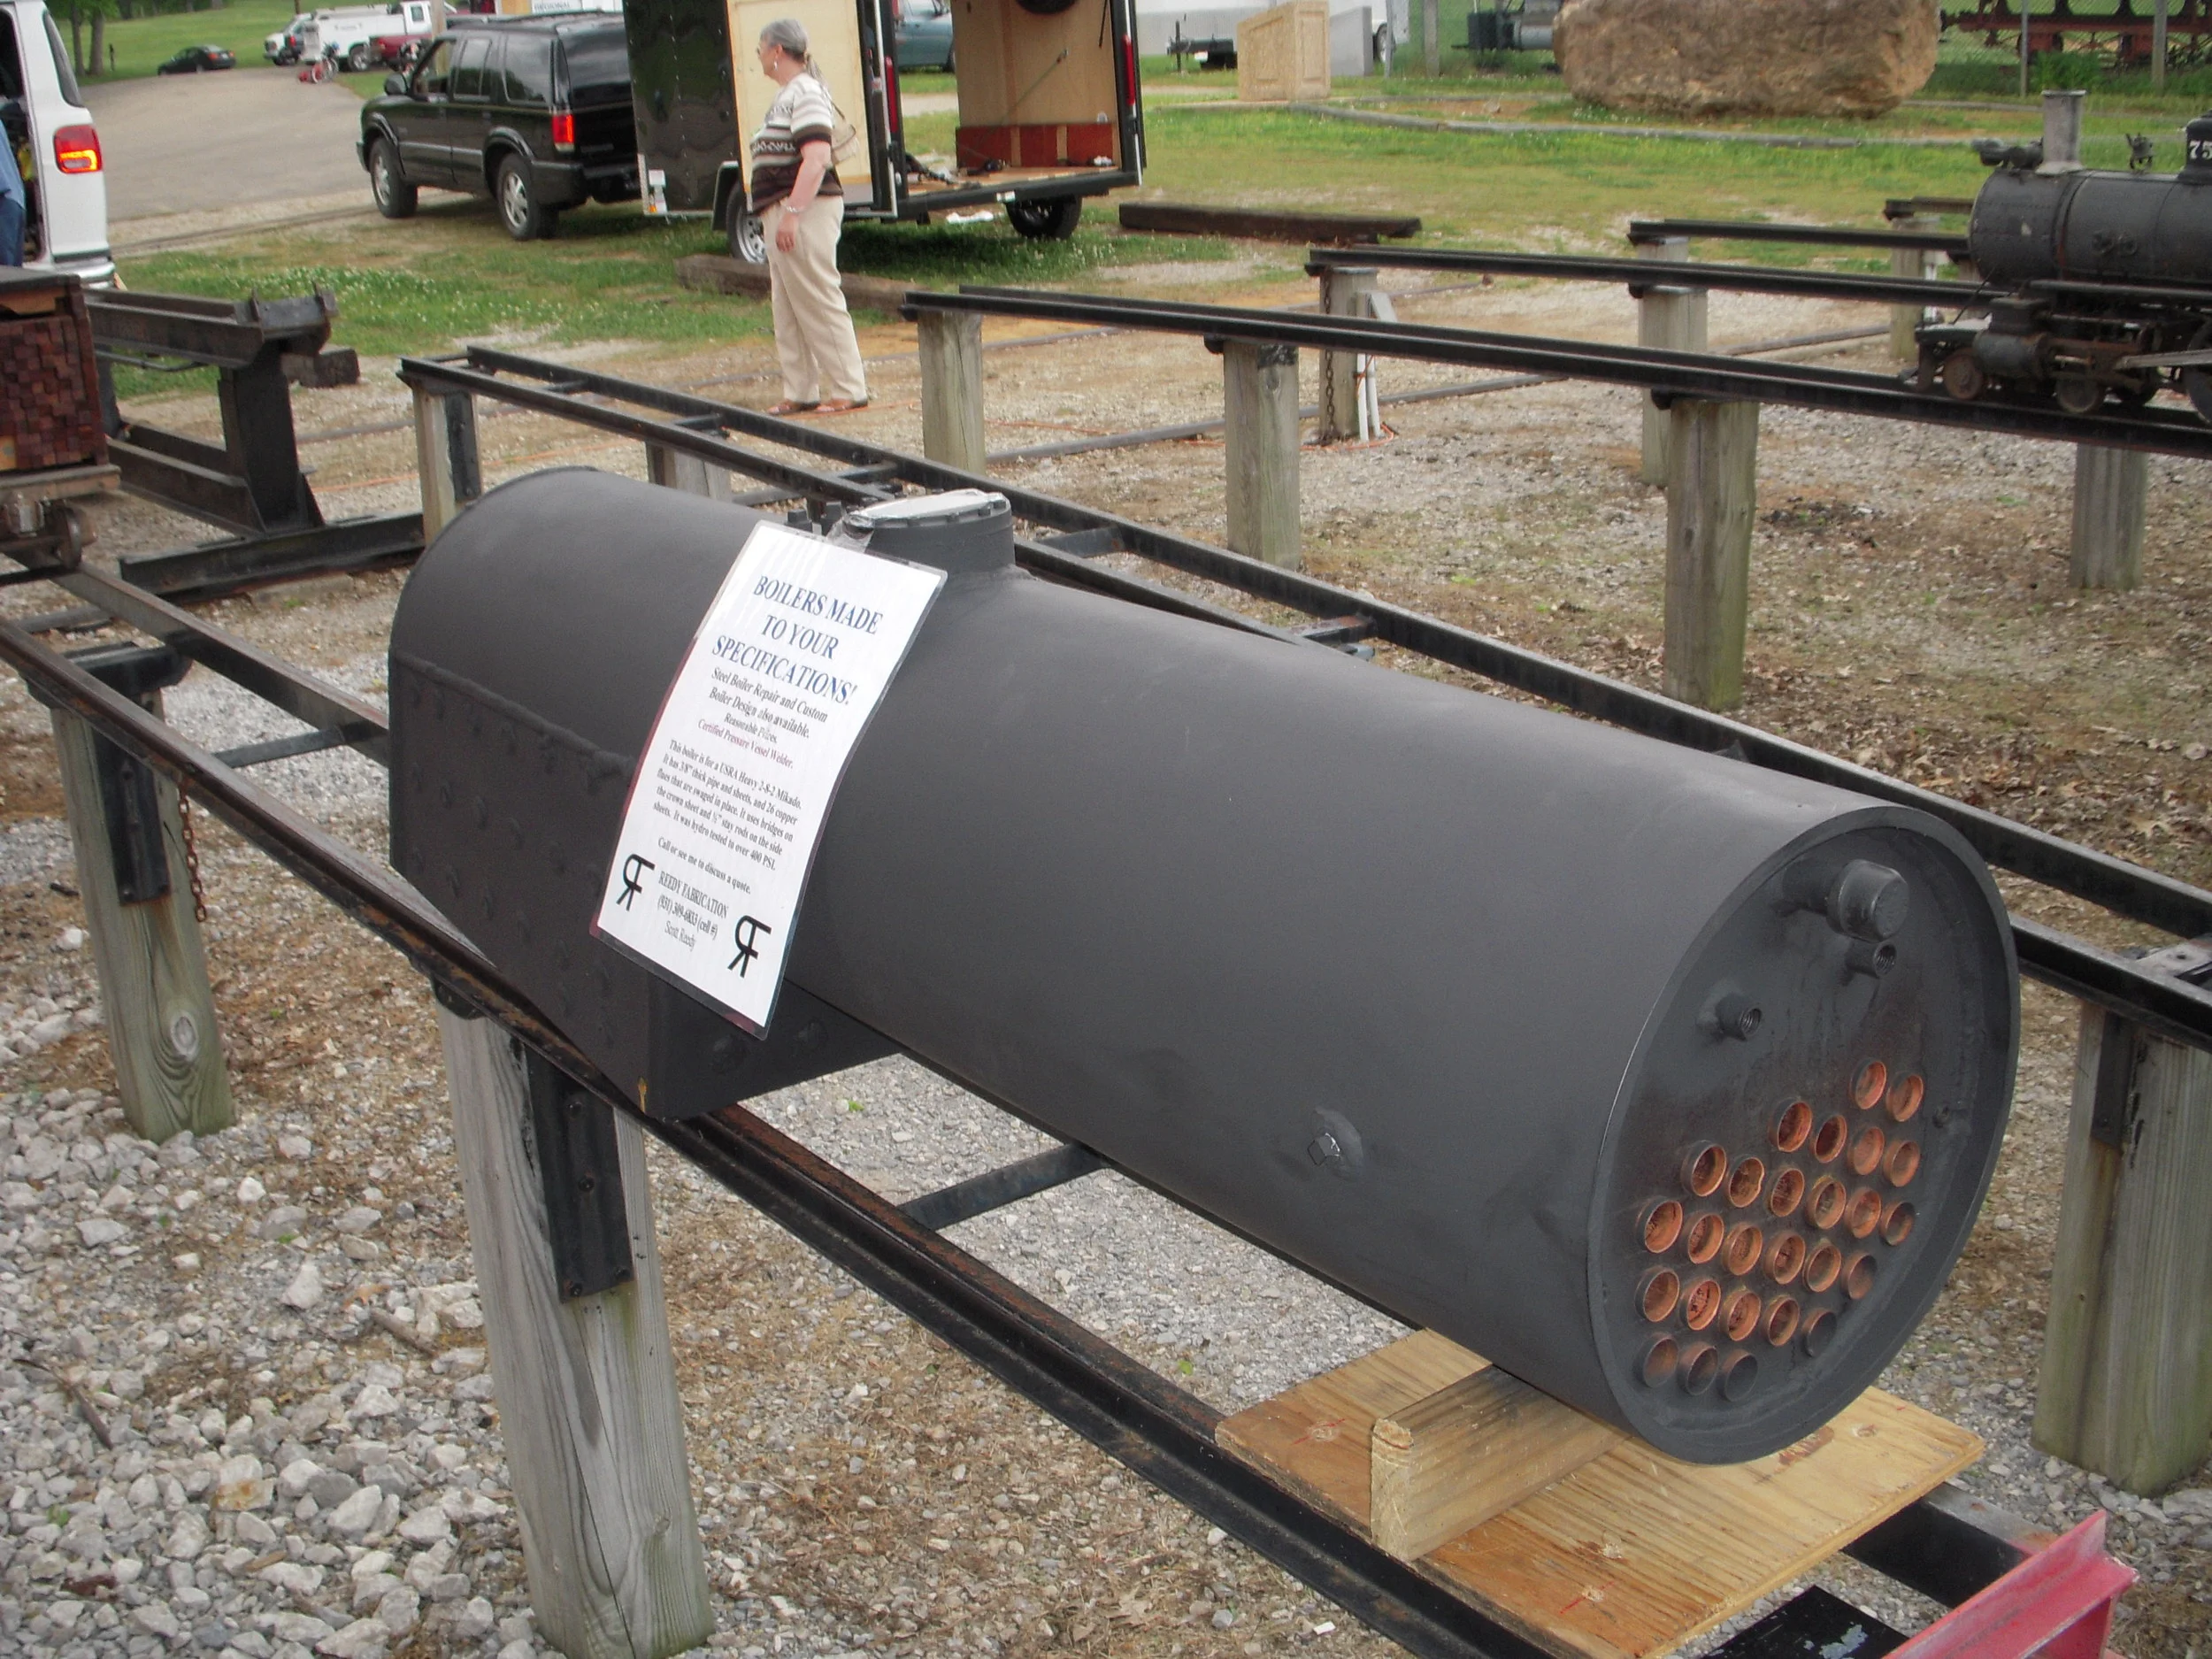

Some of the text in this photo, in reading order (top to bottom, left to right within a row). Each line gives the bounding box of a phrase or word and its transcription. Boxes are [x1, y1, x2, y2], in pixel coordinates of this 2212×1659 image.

[754, 576, 883, 634] BOILERS MADE
[762, 615, 839, 659] TO YOUR
[711, 667, 828, 723] Steel Boiler Repair and Custom
[712, 635, 858, 705] SPECIFICATIONS!
[710, 687, 810, 738] Boiler Design also available.
[725, 713, 758, 735] Reasonable
[698, 718, 793, 769] Certified Pressure Vessel Welder.
[664, 754, 669, 764] It
[669, 757, 679, 770] has
[691, 767, 707, 783] thick
[706, 776, 720, 790] pipe
[720, 782, 733, 795] and
[733, 787, 752, 805] sheets,
[754, 797, 766, 810] and
[766, 803, 775, 814] 26
[774, 810, 797, 826] copper
[669, 740, 681, 753] This
[681, 744, 699, 761] boiler
[698, 754, 703, 763] is
[703, 755, 714, 768] for
[719, 763, 738, 779] USRA
[738, 771, 759, 791] Heavy
[758, 781, 775, 796] 2-8-2
[775, 788, 802, 810] Mikado.
[654, 802, 671, 817] sheets.
[673, 810, 680, 821] It
[680, 816, 691, 826] was
[691, 818, 710, 835] hydro
[709, 829, 728, 846] tested
[727, 837, 734, 848] to
[735, 843, 749, 856] over
[750, 849, 762, 863] 400
[657, 768, 793, 841] flues that are swaged in place. It uses bridges on
[657, 786, 667, 797] the
[666, 792, 687, 805] crown
[685, 800, 700, 814] sheet
[699, 808, 712, 819] and
[721, 818, 733, 833] stay
[733, 825, 749, 838] rods
[749, 832, 758, 841] on
[757, 835, 770, 849] the
[770, 841, 783, 855] side
[658, 837, 670, 850] Call
[670, 844, 679, 853] or
[678, 849, 687, 860] see
[687, 855, 698, 864] me
[698, 858, 704, 869] to
[704, 862, 726, 882] discuss
[732, 878, 751, 895] quote.
[658, 871, 729, 918] REEDY FABRICATION
